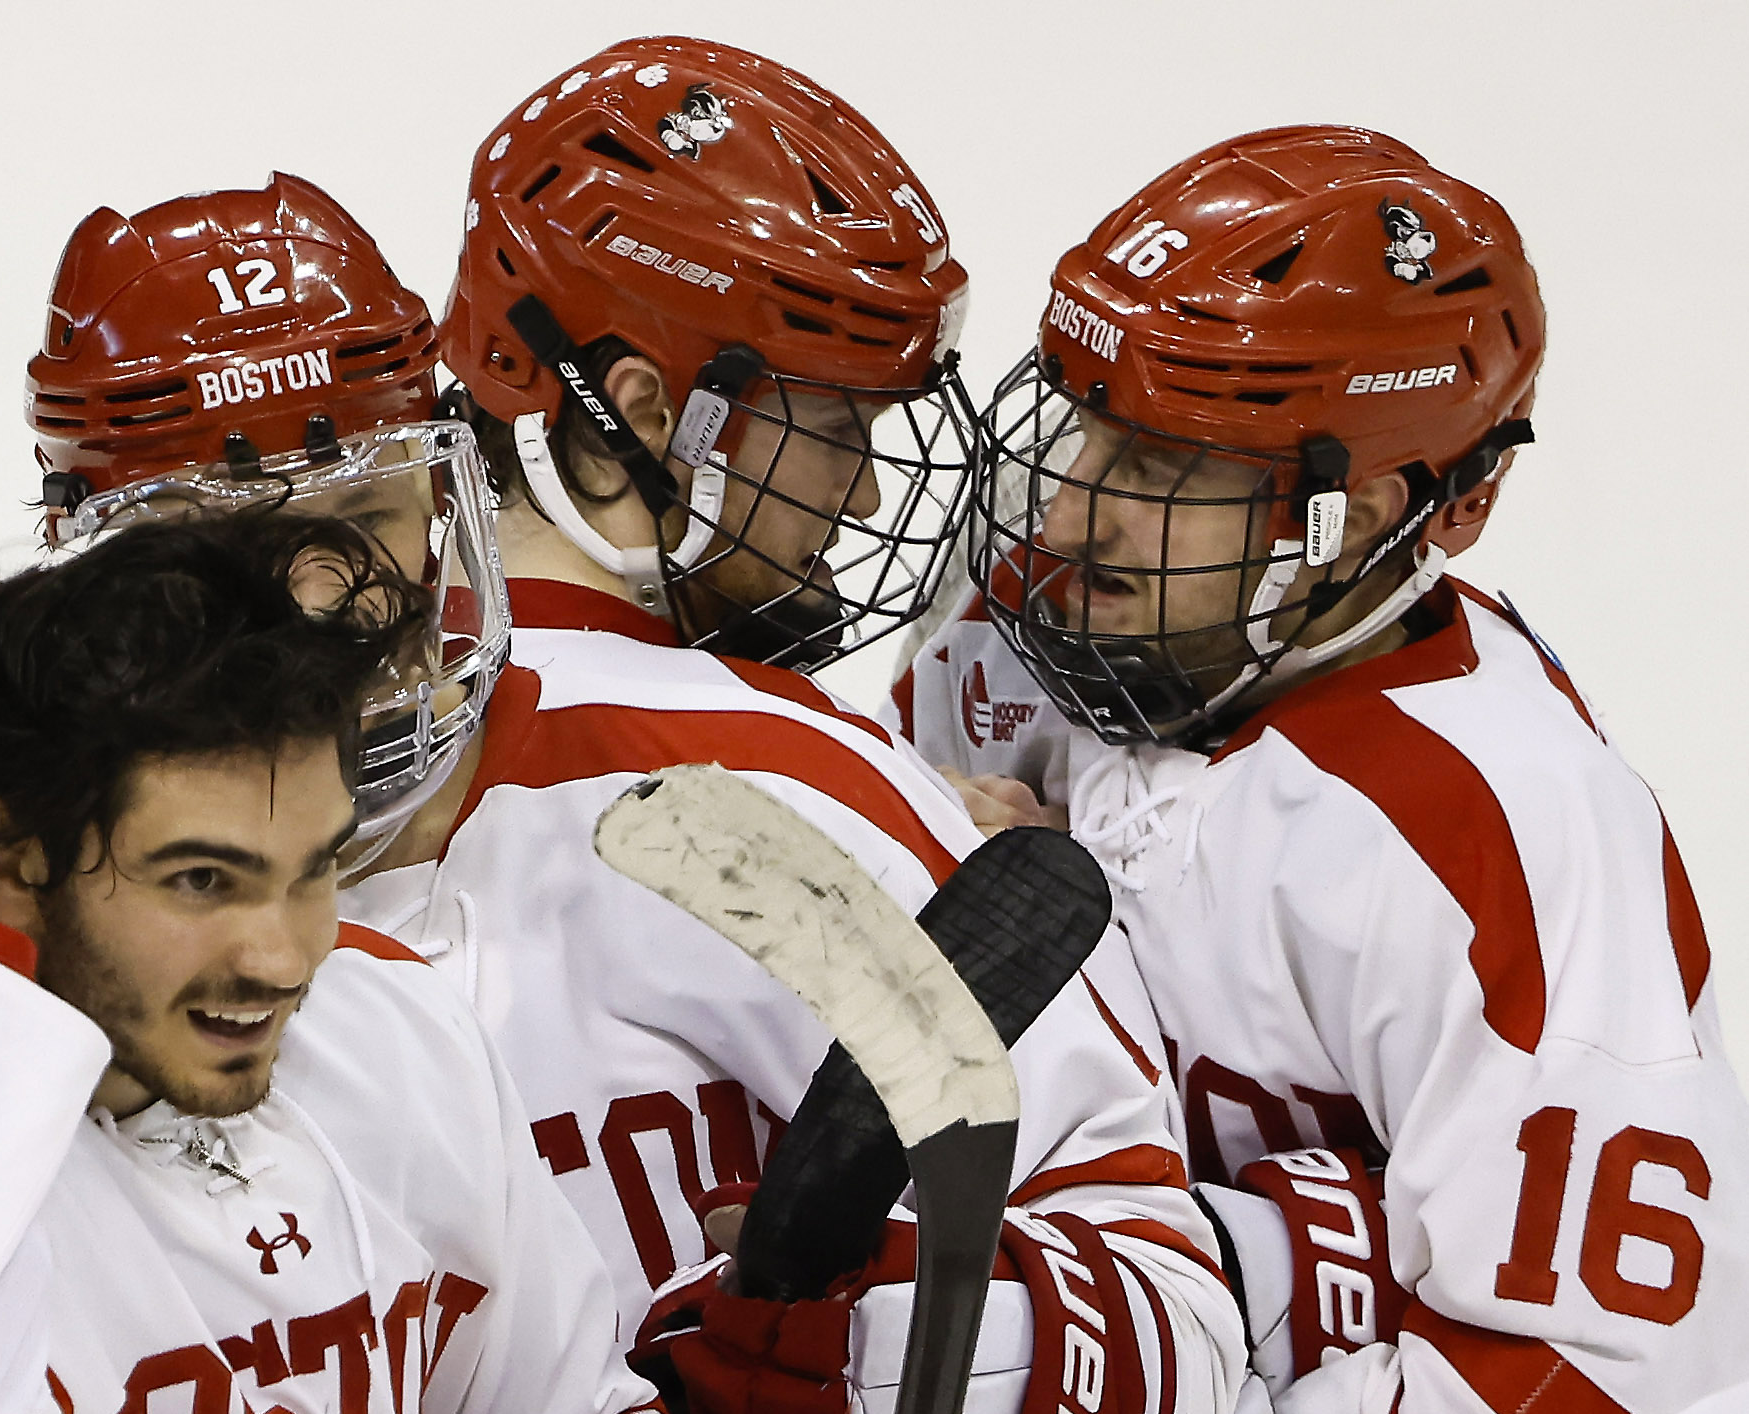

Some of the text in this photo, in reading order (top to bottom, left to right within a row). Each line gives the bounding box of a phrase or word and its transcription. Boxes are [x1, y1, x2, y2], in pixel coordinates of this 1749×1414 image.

[1105, 219, 1189, 278] 16
[207, 258, 286, 315] 12
[1049, 289, 1125, 363] BOSTON
[196, 347, 333, 410] BOSTON
[1493, 1105, 1712, 1327] 16
